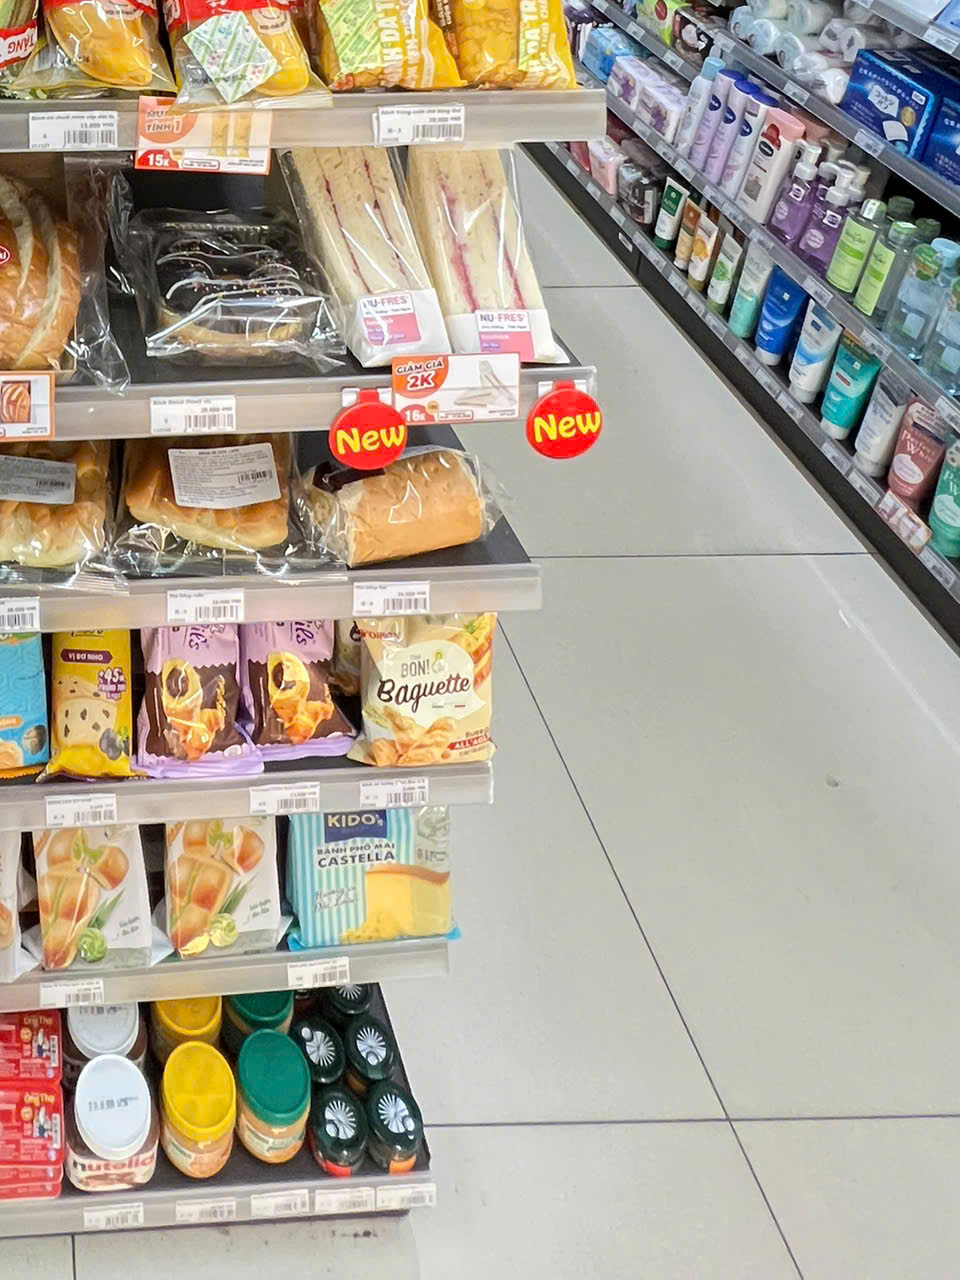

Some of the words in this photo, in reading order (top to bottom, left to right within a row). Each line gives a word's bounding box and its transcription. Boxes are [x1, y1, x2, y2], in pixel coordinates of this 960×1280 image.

[396, 364, 424, 374] GIẢM
[425, 358, 444, 369] GIÁ
[407, 374, 435, 388] 2K
[534, 411, 602, 443] New
[335, 424, 406, 455] New
[401, 659, 431, 678] BON!
[377, 673, 470, 713] Baguette
[374, 842, 395, 850] MAI
[318, 851, 395, 869] CASTELLA
